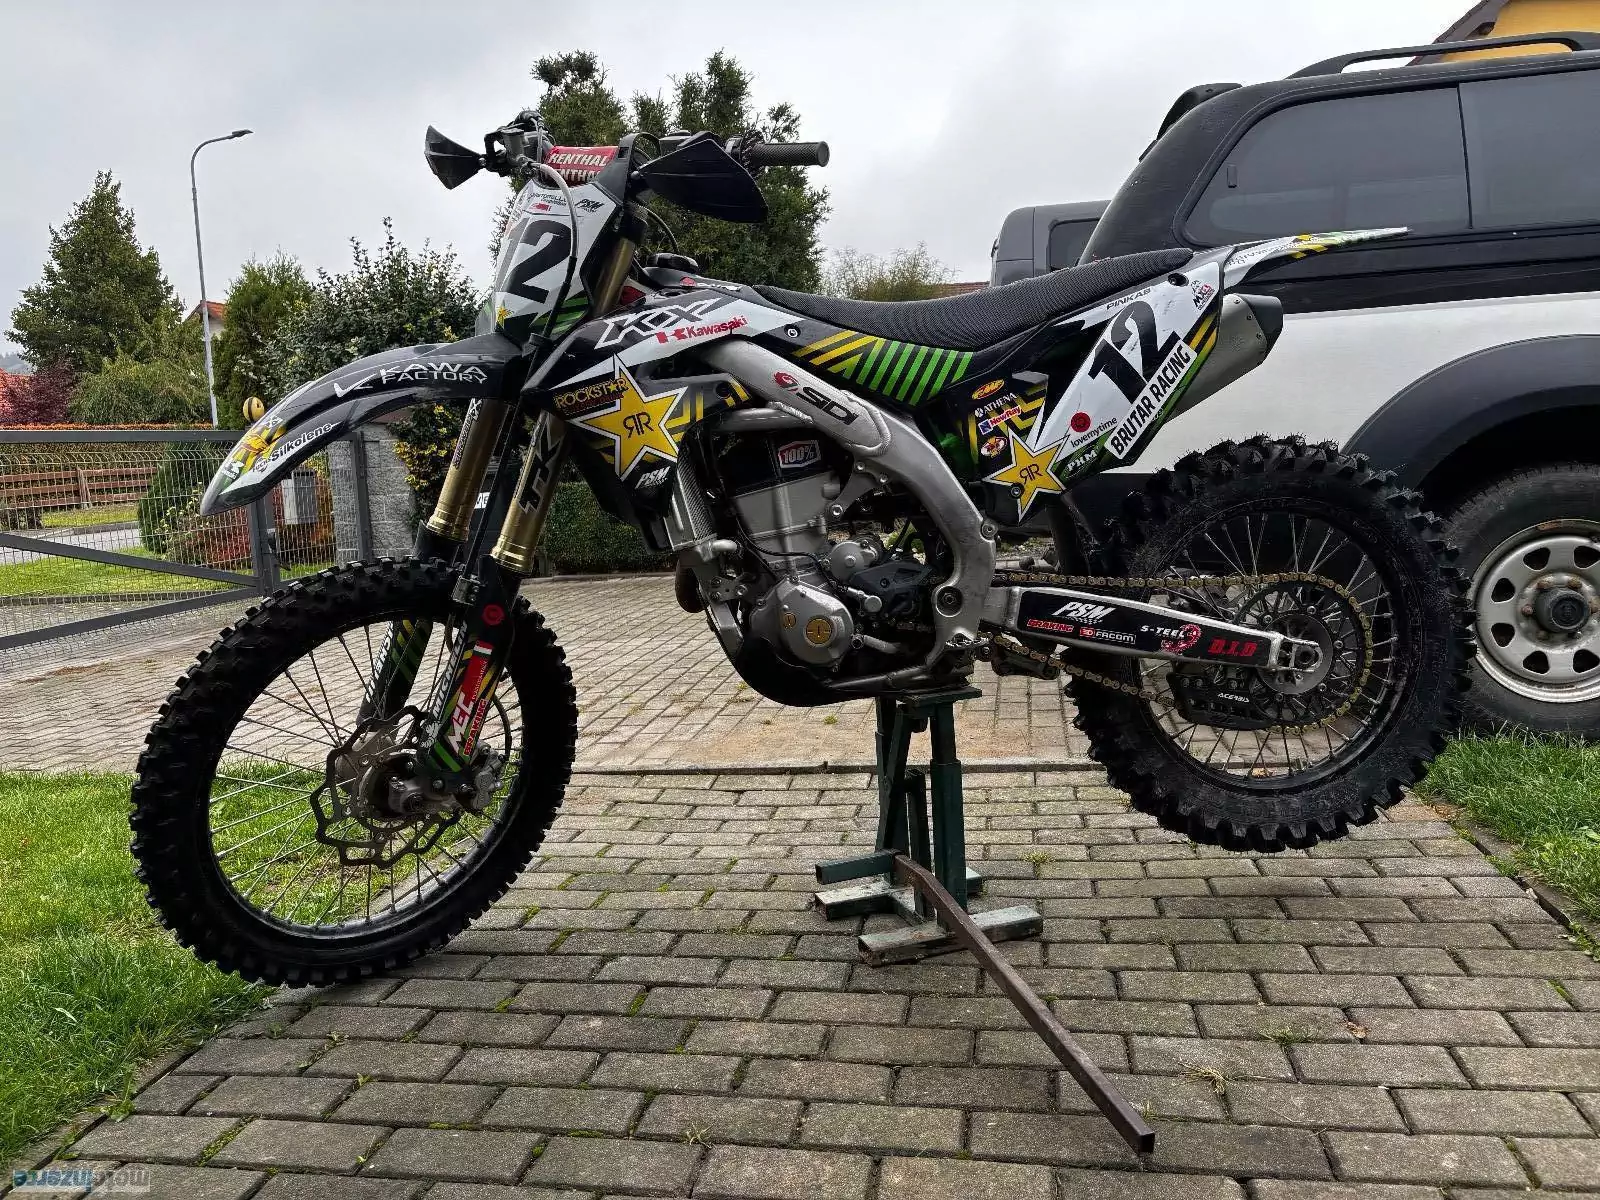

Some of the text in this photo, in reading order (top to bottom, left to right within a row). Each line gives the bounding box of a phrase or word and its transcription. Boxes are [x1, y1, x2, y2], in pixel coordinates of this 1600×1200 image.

[686, 315, 749, 338] Kawasaki
[1087, 300, 1184, 404] 12
[380, 362, 488, 379] KAWA
[381, 371, 488, 385] FACTORY
[984, 392, 1018, 415] ATHENA
[1111, 344, 1191, 455] BRUTAR RACING
[272, 423, 332, 462] Silkolene
[1070, 416, 1118, 448] lovemytime
[783, 444, 816, 464] 100%
[1027, 618, 1075, 633] BRAKING
[1095, 630, 1135, 643] FACOM
[1140, 625, 1186, 639] S-TEEL
[433, 620, 468, 720] MICHELIN
[463, 698, 487, 756] BRAKING
